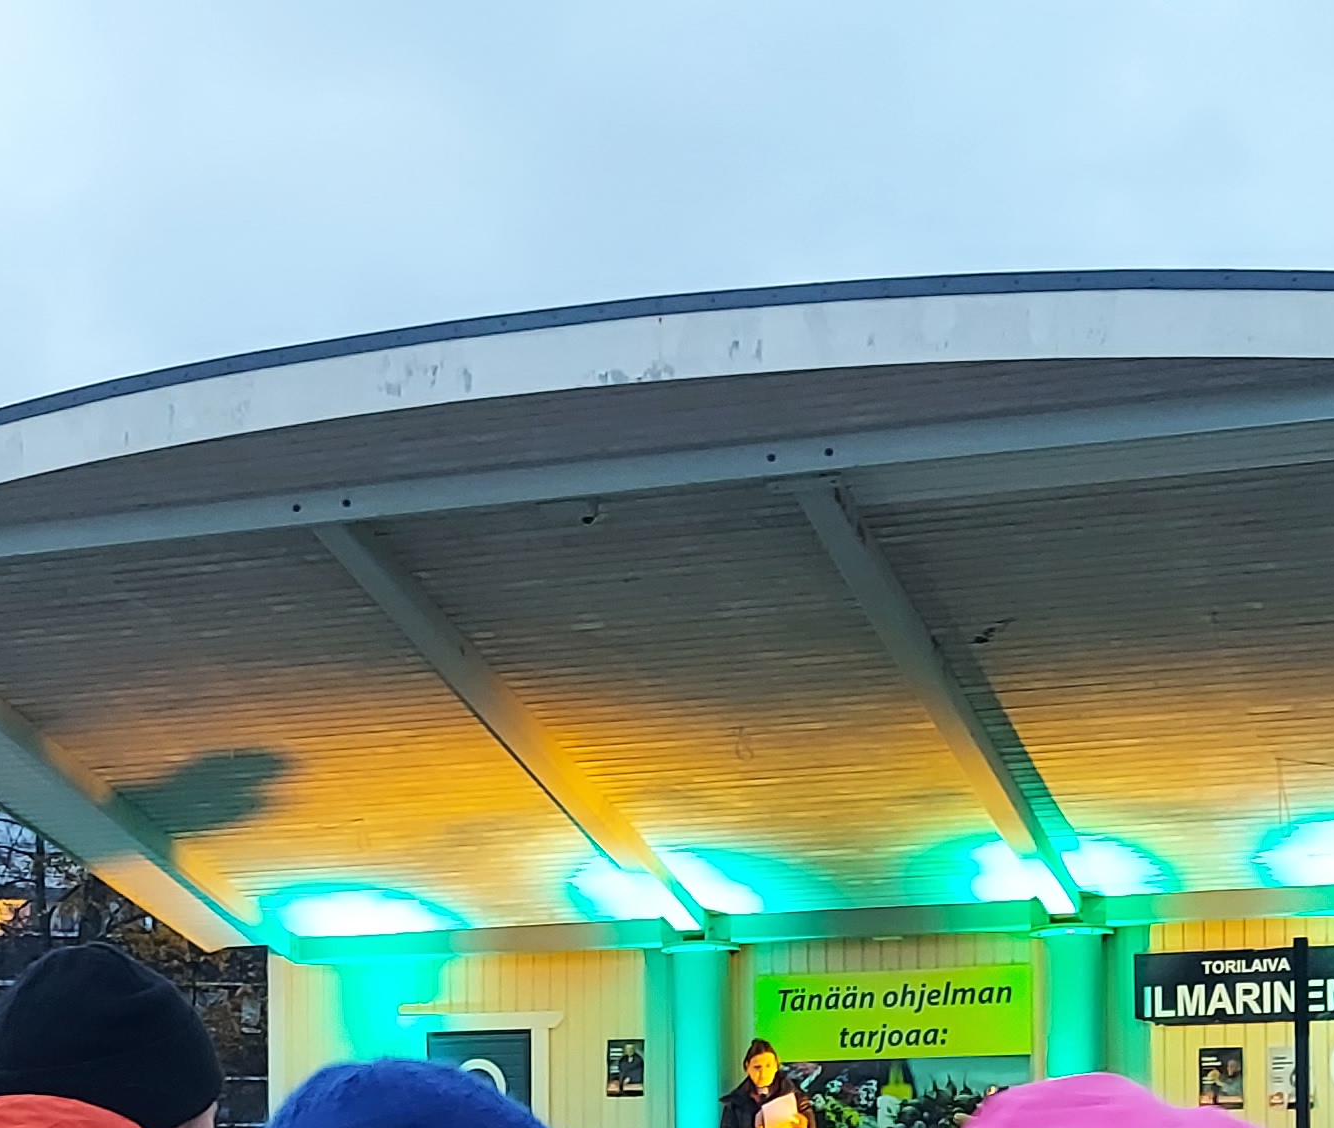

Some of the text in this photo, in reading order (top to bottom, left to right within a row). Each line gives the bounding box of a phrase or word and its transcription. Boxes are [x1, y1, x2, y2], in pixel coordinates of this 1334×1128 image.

[1201, 957, 1291, 975] TORILAIVA
[778, 981, 1012, 1014] Tänään ohjelman
[839, 1023, 948, 1054] tarjoaa:
